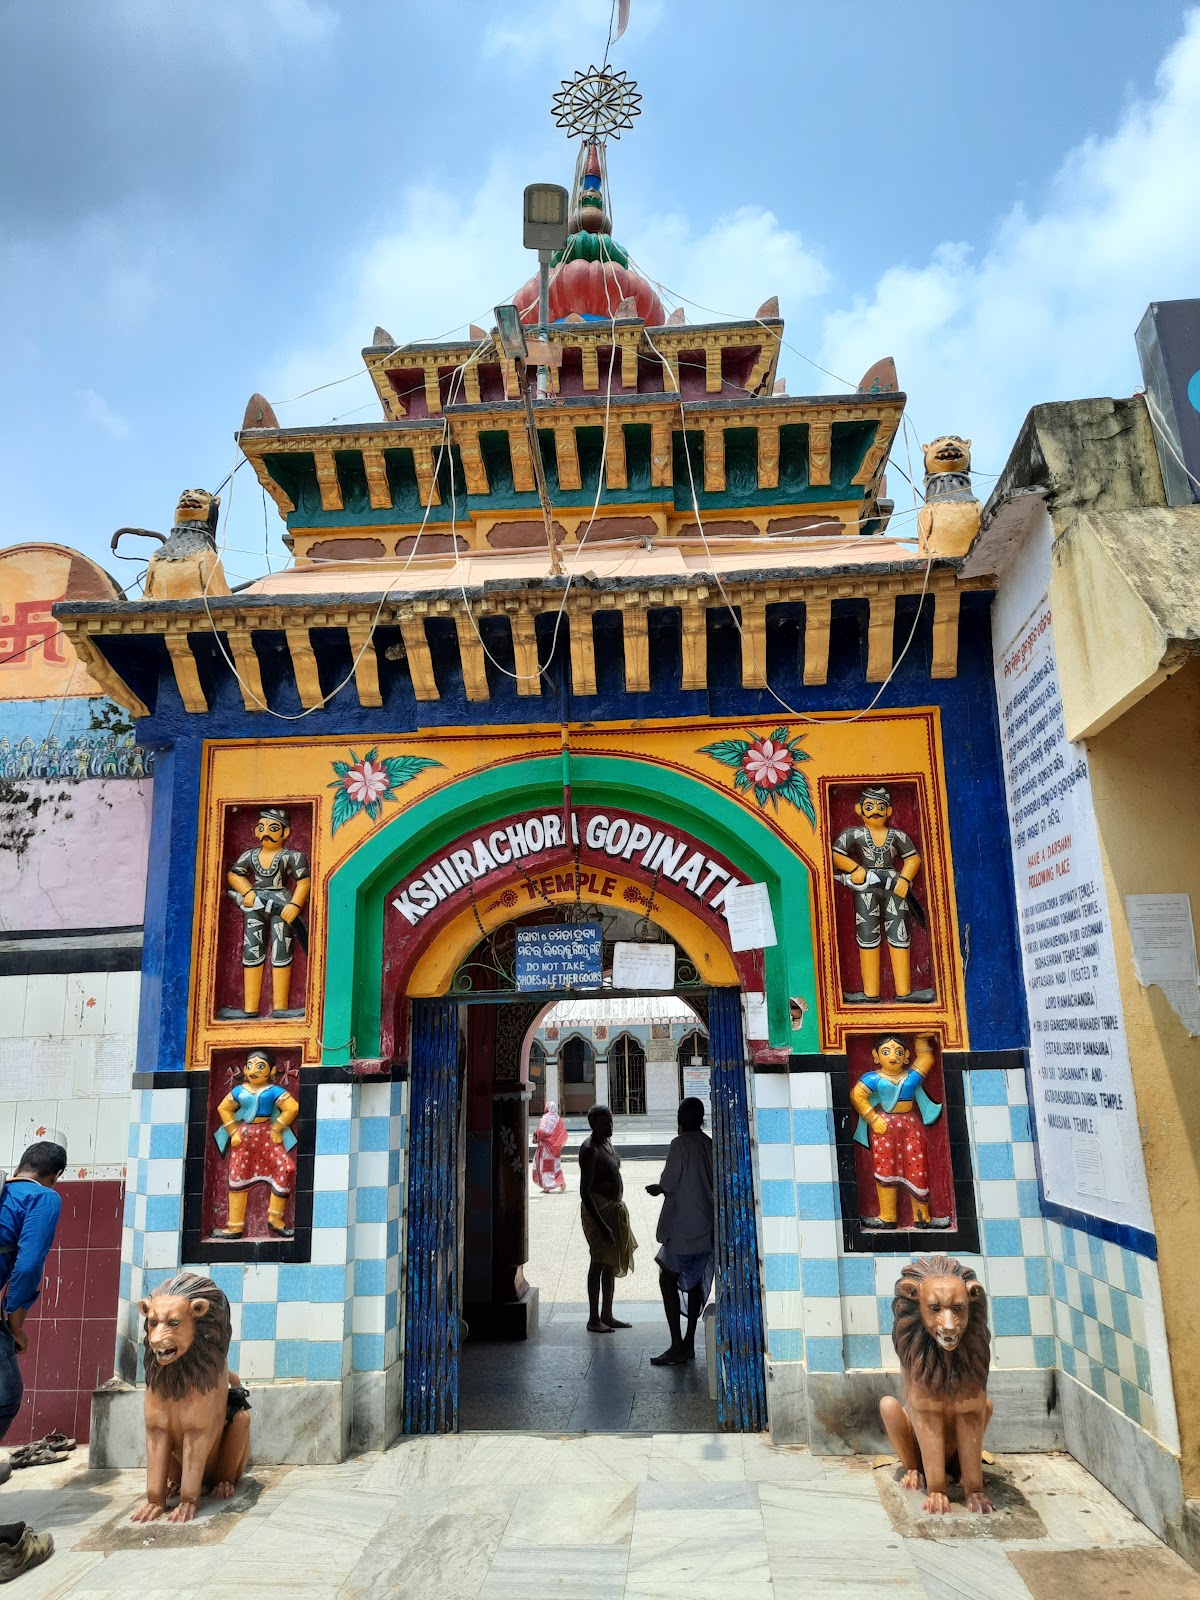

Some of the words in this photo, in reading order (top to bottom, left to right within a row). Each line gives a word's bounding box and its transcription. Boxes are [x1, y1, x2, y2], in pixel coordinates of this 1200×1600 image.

[1027, 851, 1040, 869] HAVE
[1042, 848, 1046, 861] A
[1048, 834, 1072, 859] DARSHAN
[392, 813, 579, 926] KSHIRACHORA
[1028, 866, 1054, 889] FOLLOWING
[1056, 858, 1070, 878] PLACE
[520, 872, 618, 900] TEMPLE
[518, 942, 544, 958] ମନ୍ଦିର
[1062, 947, 1080, 963] TEMPLE
[526, 962, 539, 972] DO
[542, 962, 559, 972] NOT
[561, 961, 585, 971] TAKE
[1055, 971, 1066, 985] NADI
[1091, 964, 1098, 978] BY
[516, 974, 541, 986] SHOES
[1045, 996, 1056, 1010] LORD
[1079, 1017, 1100, 1030] MAHADEV
[1100, 1015, 1118, 1030] TEMPLE
[1076, 1041, 1081, 1055] BY
[1057, 1067, 1089, 1081] JAGANNATH
[1091, 1067, 1103, 1082] AND
[1081, 1091, 1098, 1107] DURGA
[1047, 1113, 1071, 1130] MAUSIMA
